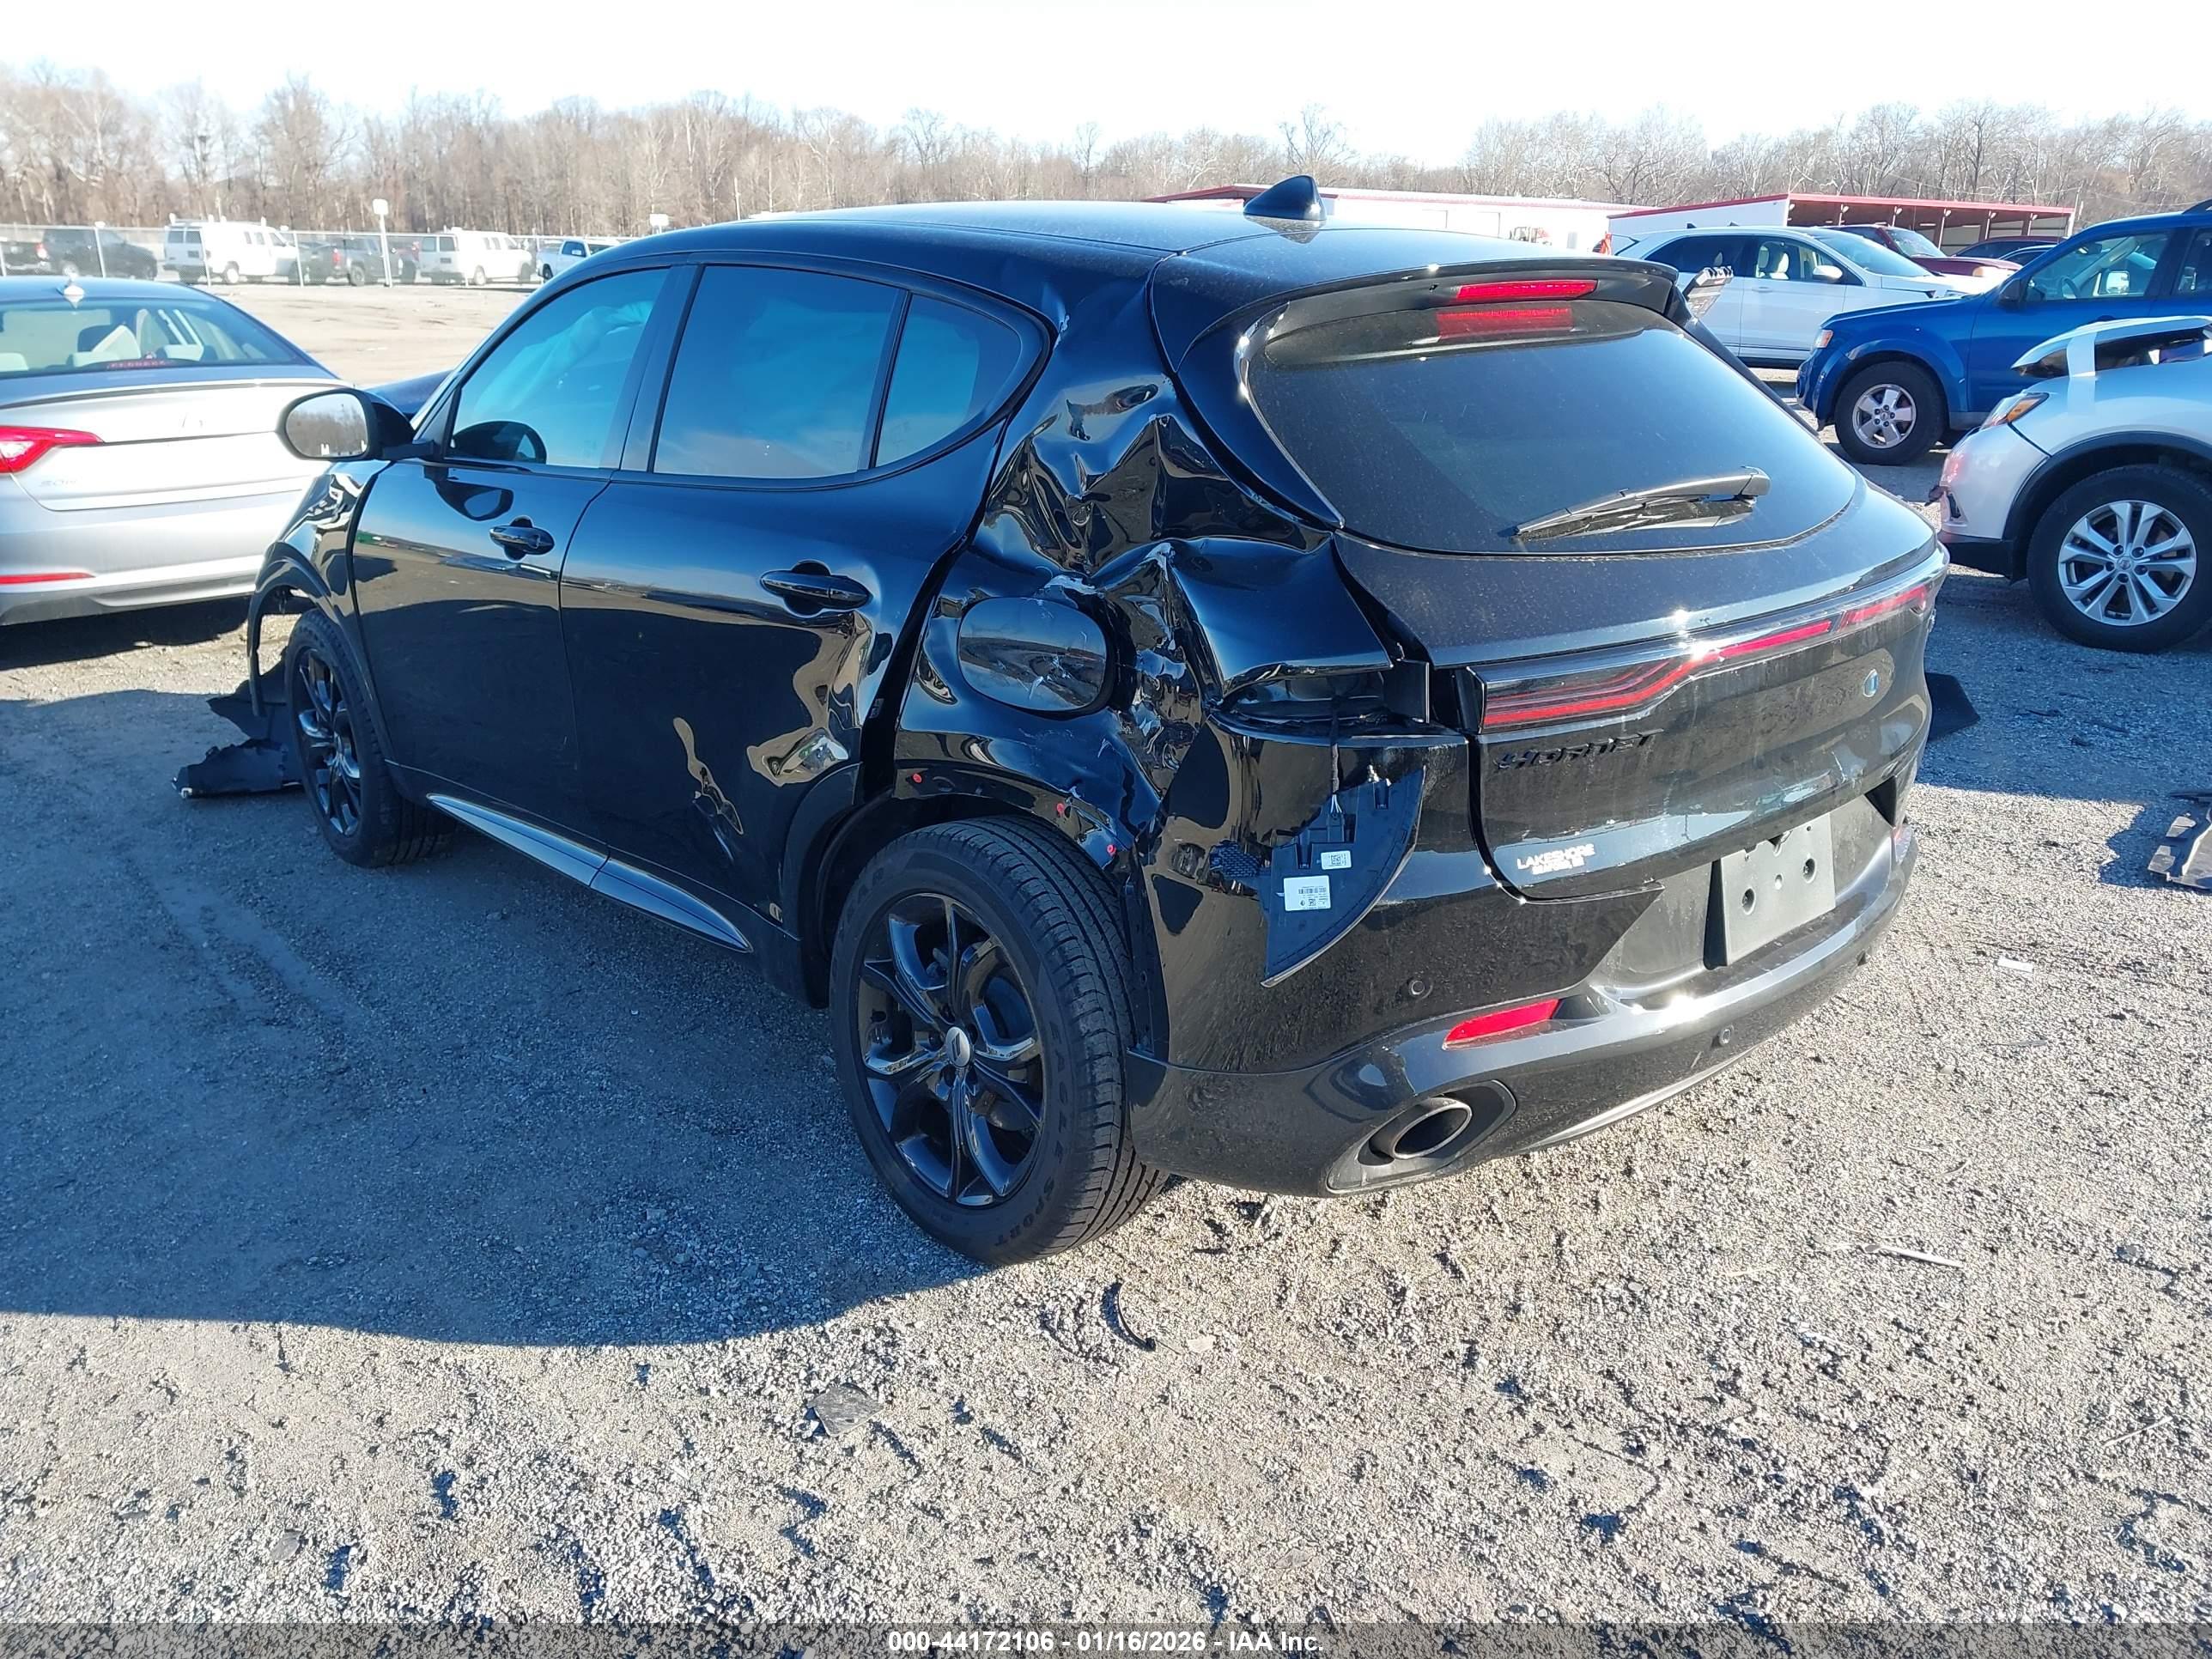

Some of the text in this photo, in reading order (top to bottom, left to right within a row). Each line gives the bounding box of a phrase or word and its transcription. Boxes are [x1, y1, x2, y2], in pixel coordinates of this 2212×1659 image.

[1493, 728, 1664, 770] HORNET
[1516, 843, 1596, 869] LAKESHORE
[994, 1176, 1055, 1247] SPORT
